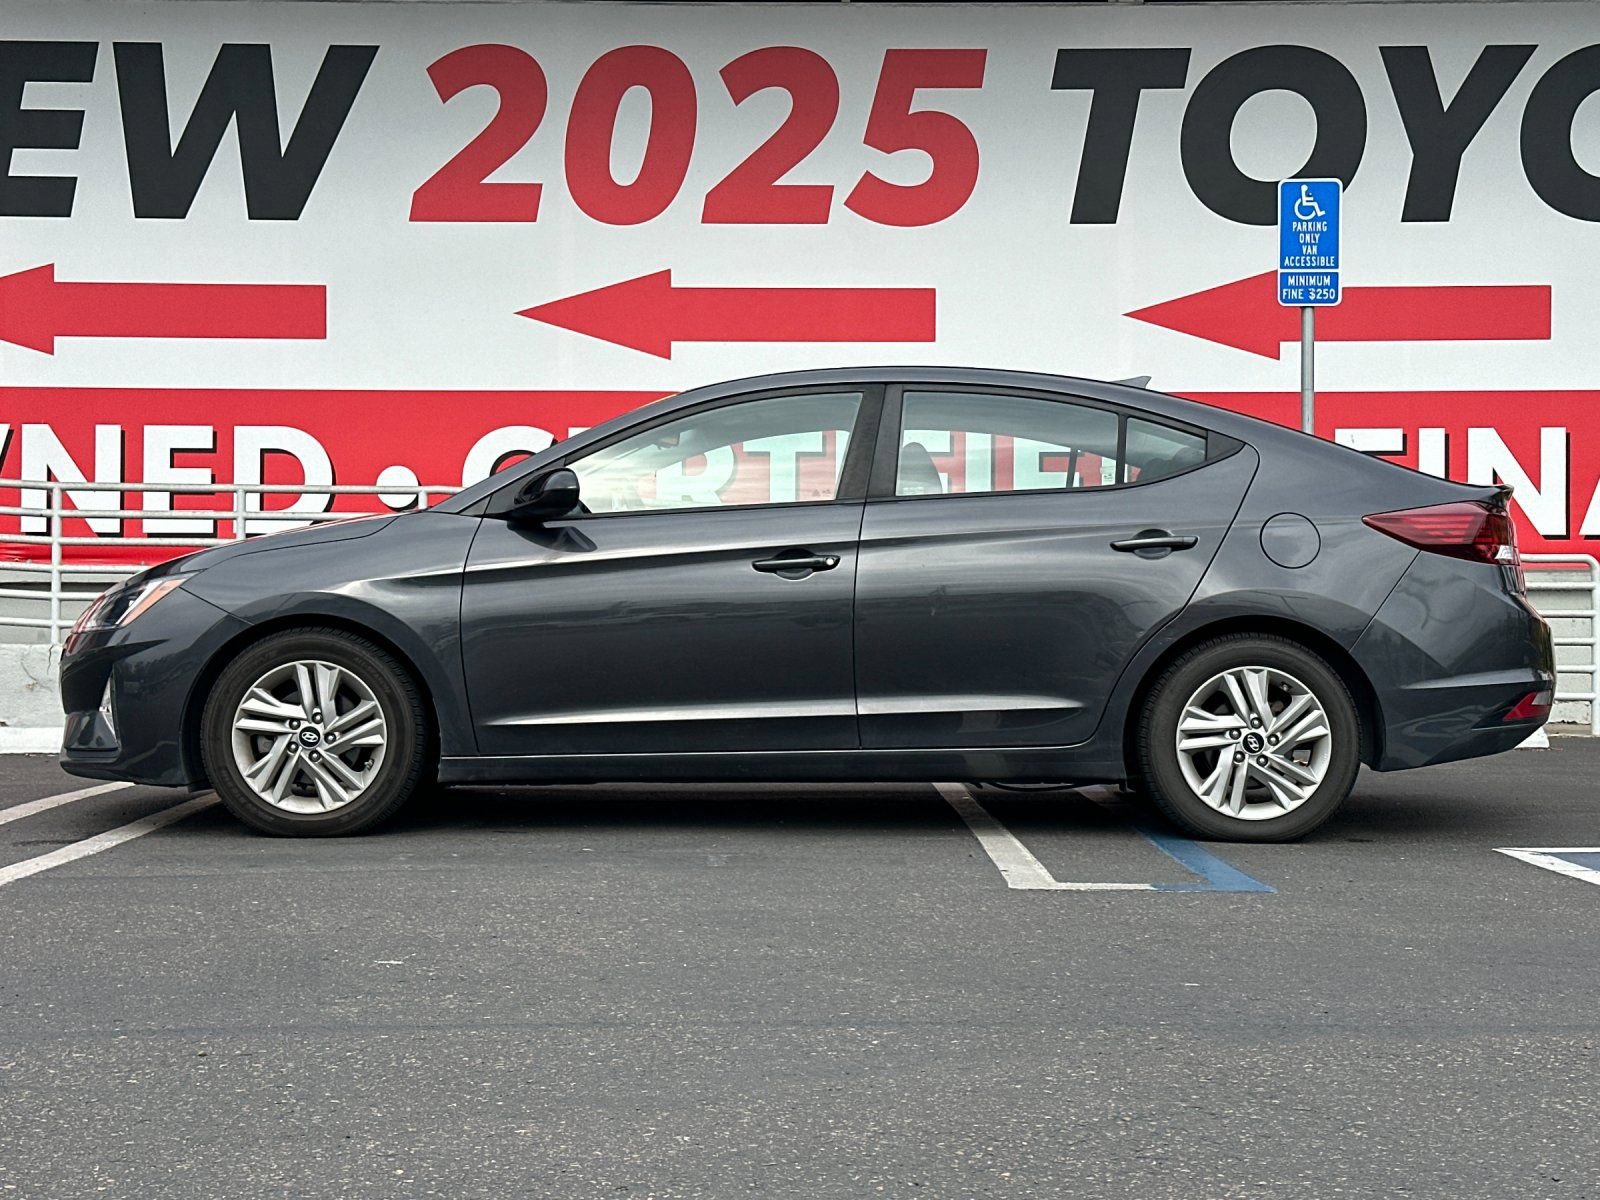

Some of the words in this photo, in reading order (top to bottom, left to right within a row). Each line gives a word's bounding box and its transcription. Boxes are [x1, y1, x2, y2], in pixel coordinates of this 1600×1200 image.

[409, 44, 987, 227] 2025
[1292, 221, 1328, 232] PARKING
[1299, 233, 1320, 244] ONLY
[1302, 245, 1318, 255] VAN
[1284, 256, 1335, 267] ACCESSIBLE
[1287, 275, 1331, 287] MINIMUM
[1282, 288, 1304, 300] FINE
[1308, 288, 1336, 300] $250
[0, 423, 336, 538] NED
